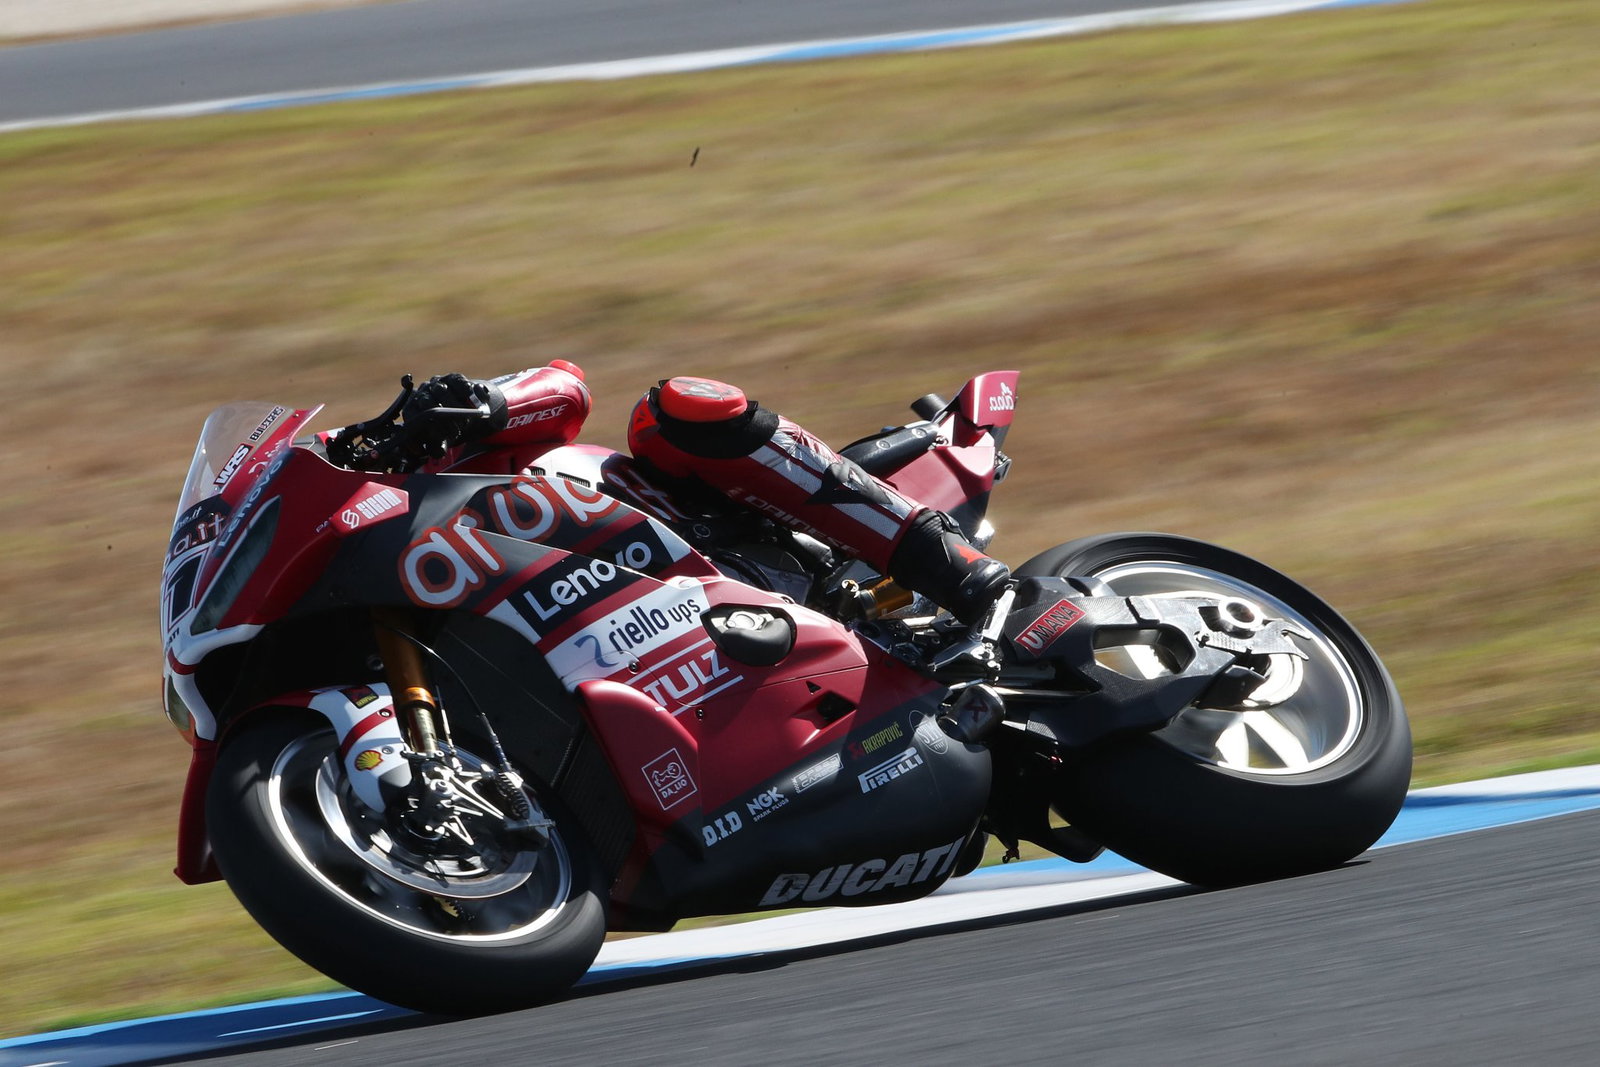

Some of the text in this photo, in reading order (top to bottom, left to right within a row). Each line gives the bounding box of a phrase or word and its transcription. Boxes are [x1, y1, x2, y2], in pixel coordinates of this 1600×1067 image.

[506, 403, 569, 429] DAINESE
[523, 541, 652, 622] Lenovo
[608, 598, 700, 654] riello ups
[1022, 605, 1079, 650] UMANA
[642, 649, 730, 708] TULZ
[858, 746, 923, 793] PIRELLI
[746, 786, 784, 816] NGK
[753, 808, 772, 822] SPARK
[702, 811, 742, 847] D.I.D
[757, 835, 966, 906] DUCATI
